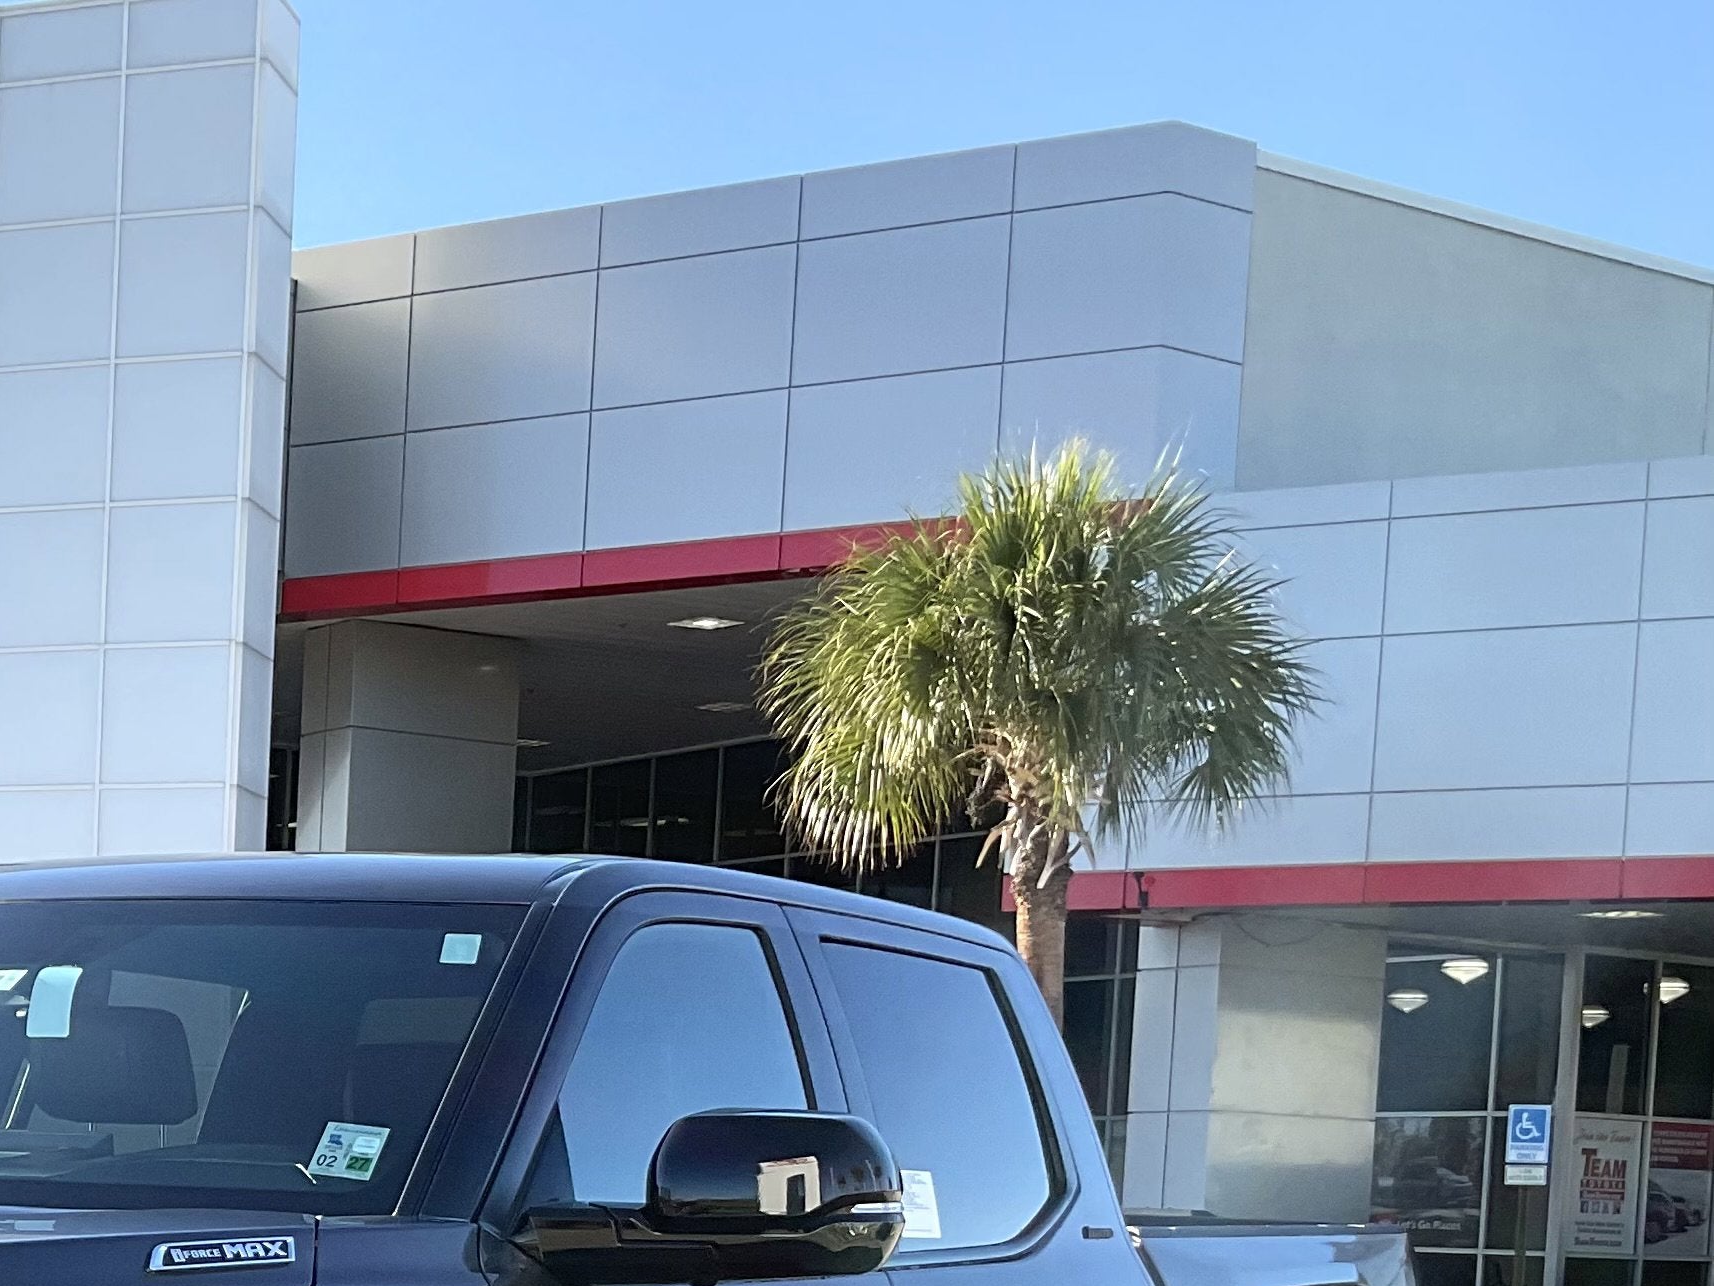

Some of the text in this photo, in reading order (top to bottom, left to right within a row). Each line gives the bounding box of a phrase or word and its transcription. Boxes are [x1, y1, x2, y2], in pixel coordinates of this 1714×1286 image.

[316, 1153, 338, 1168] 02
[346, 1156, 373, 1172] 27
[222, 1240, 288, 1259] MAX
